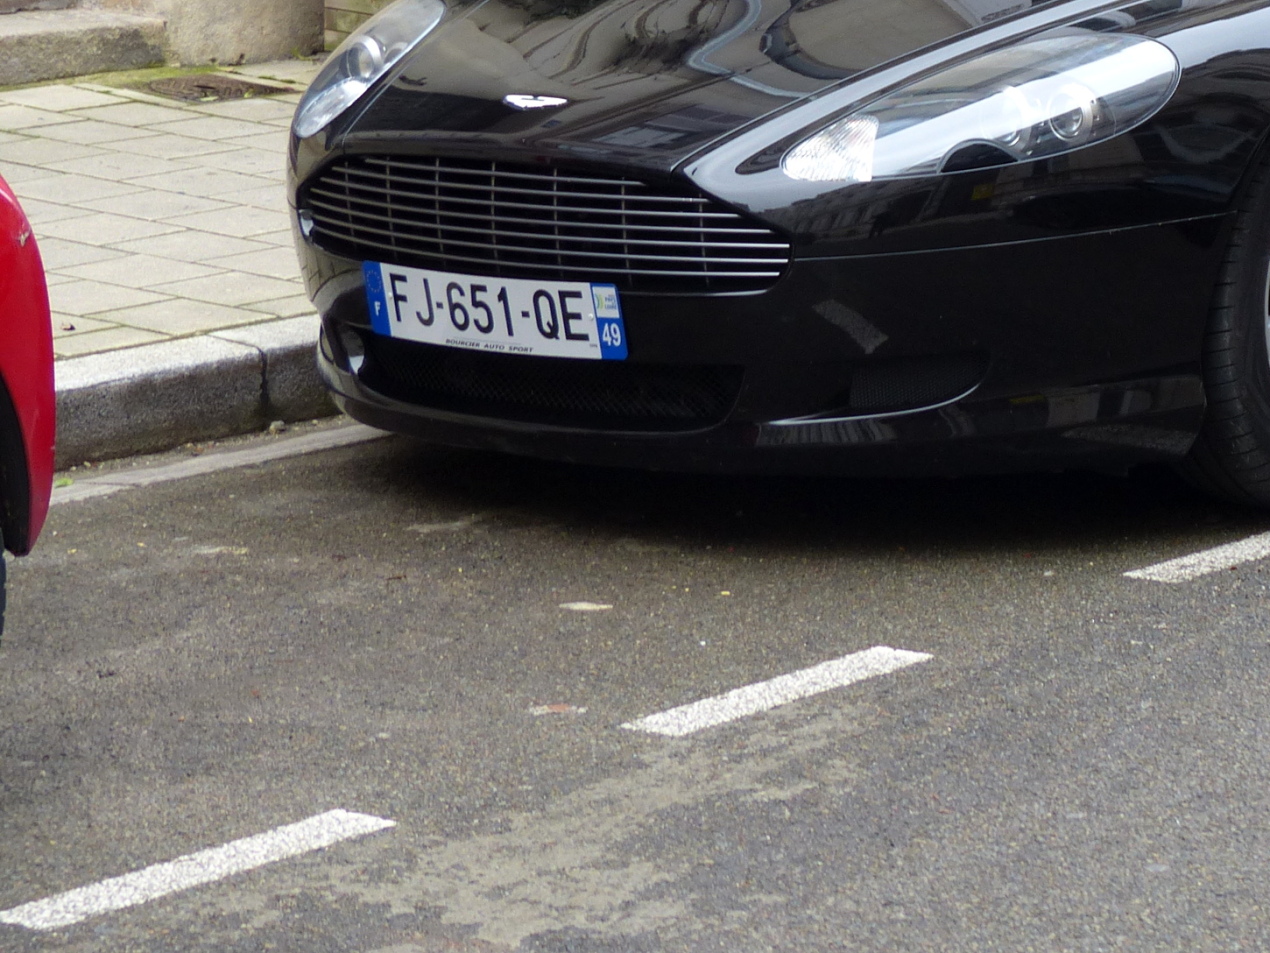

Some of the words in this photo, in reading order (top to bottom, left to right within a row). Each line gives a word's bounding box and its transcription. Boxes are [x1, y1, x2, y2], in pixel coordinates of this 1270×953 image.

[374, 300, 381, 317] F
[389, 273, 590, 341] FJ-651-QE
[602, 322, 621, 347] 49
[484, 343, 505, 351] AUTO
[508, 345, 534, 353] SPORT
